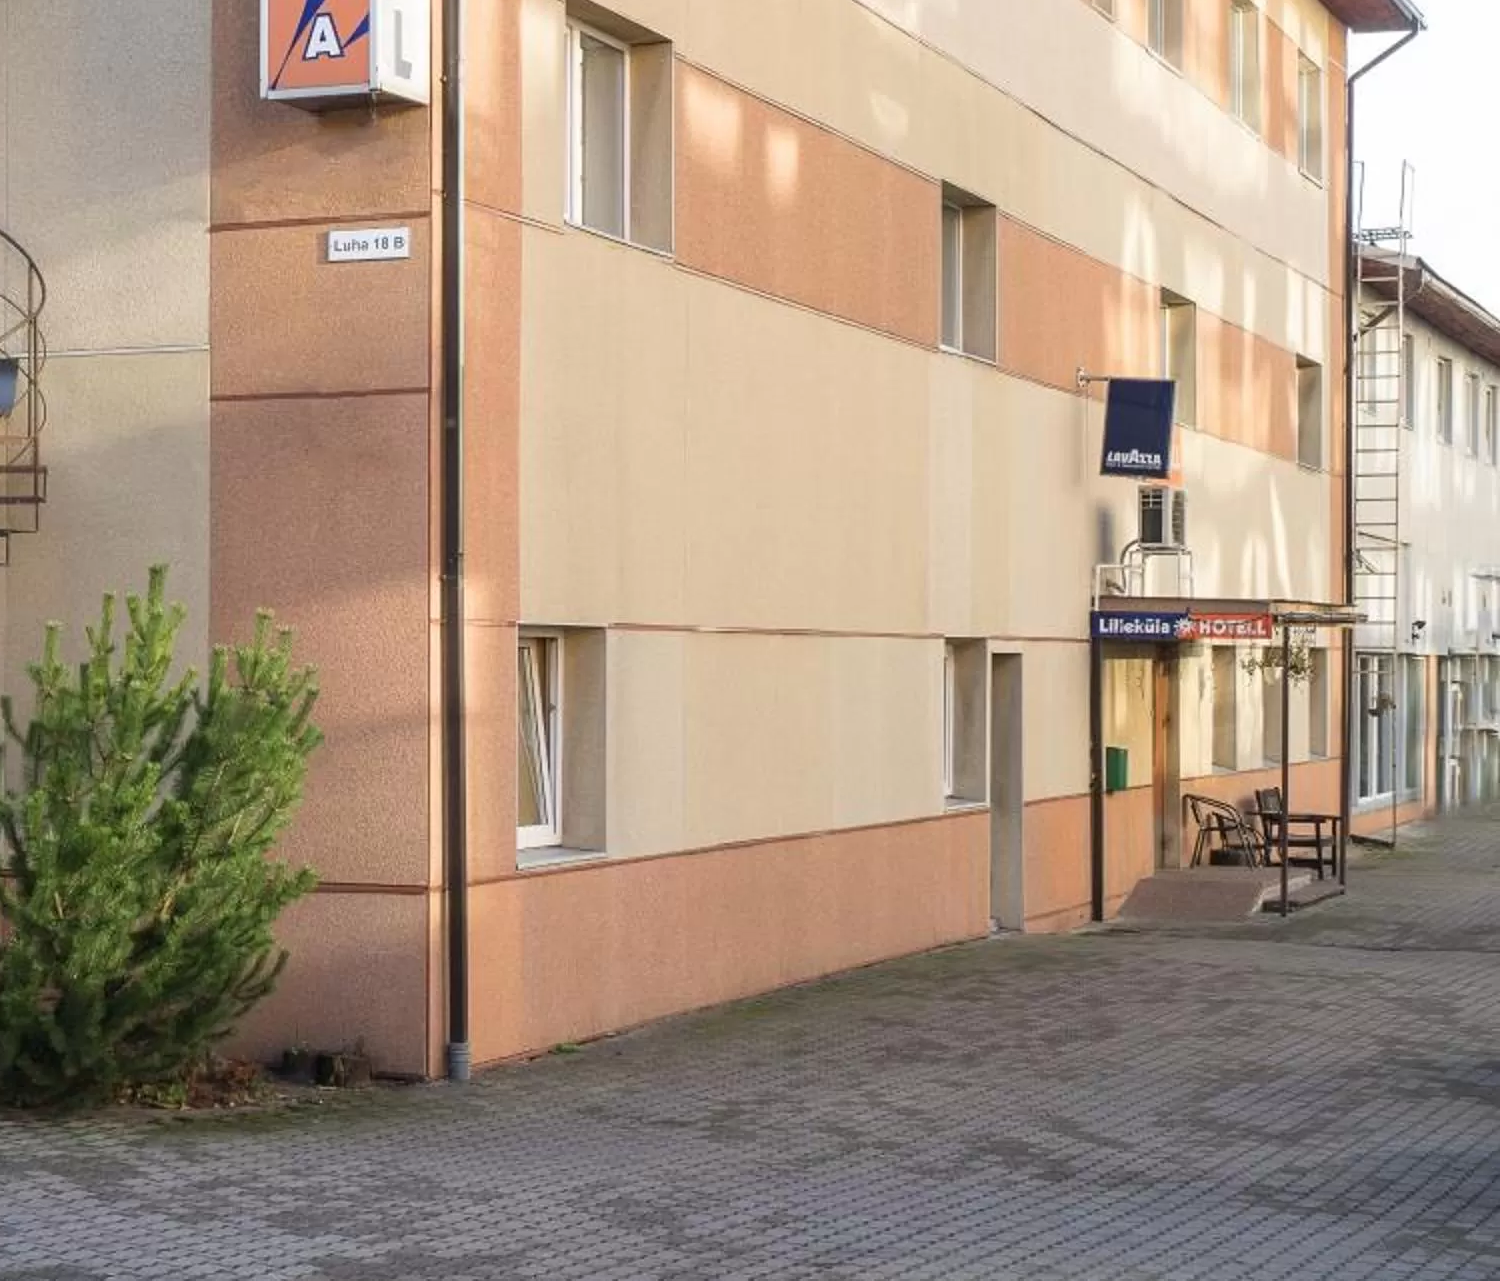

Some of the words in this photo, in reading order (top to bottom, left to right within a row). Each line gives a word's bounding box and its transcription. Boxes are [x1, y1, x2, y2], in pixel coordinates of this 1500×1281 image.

[333, 238, 369, 252] Luha
[393, 236, 405, 249] B
[1107, 449, 1161, 464] LAVAZZA
[1099, 618, 1171, 634] Lilleküla
[1199, 619, 1267, 635] HOTELL
